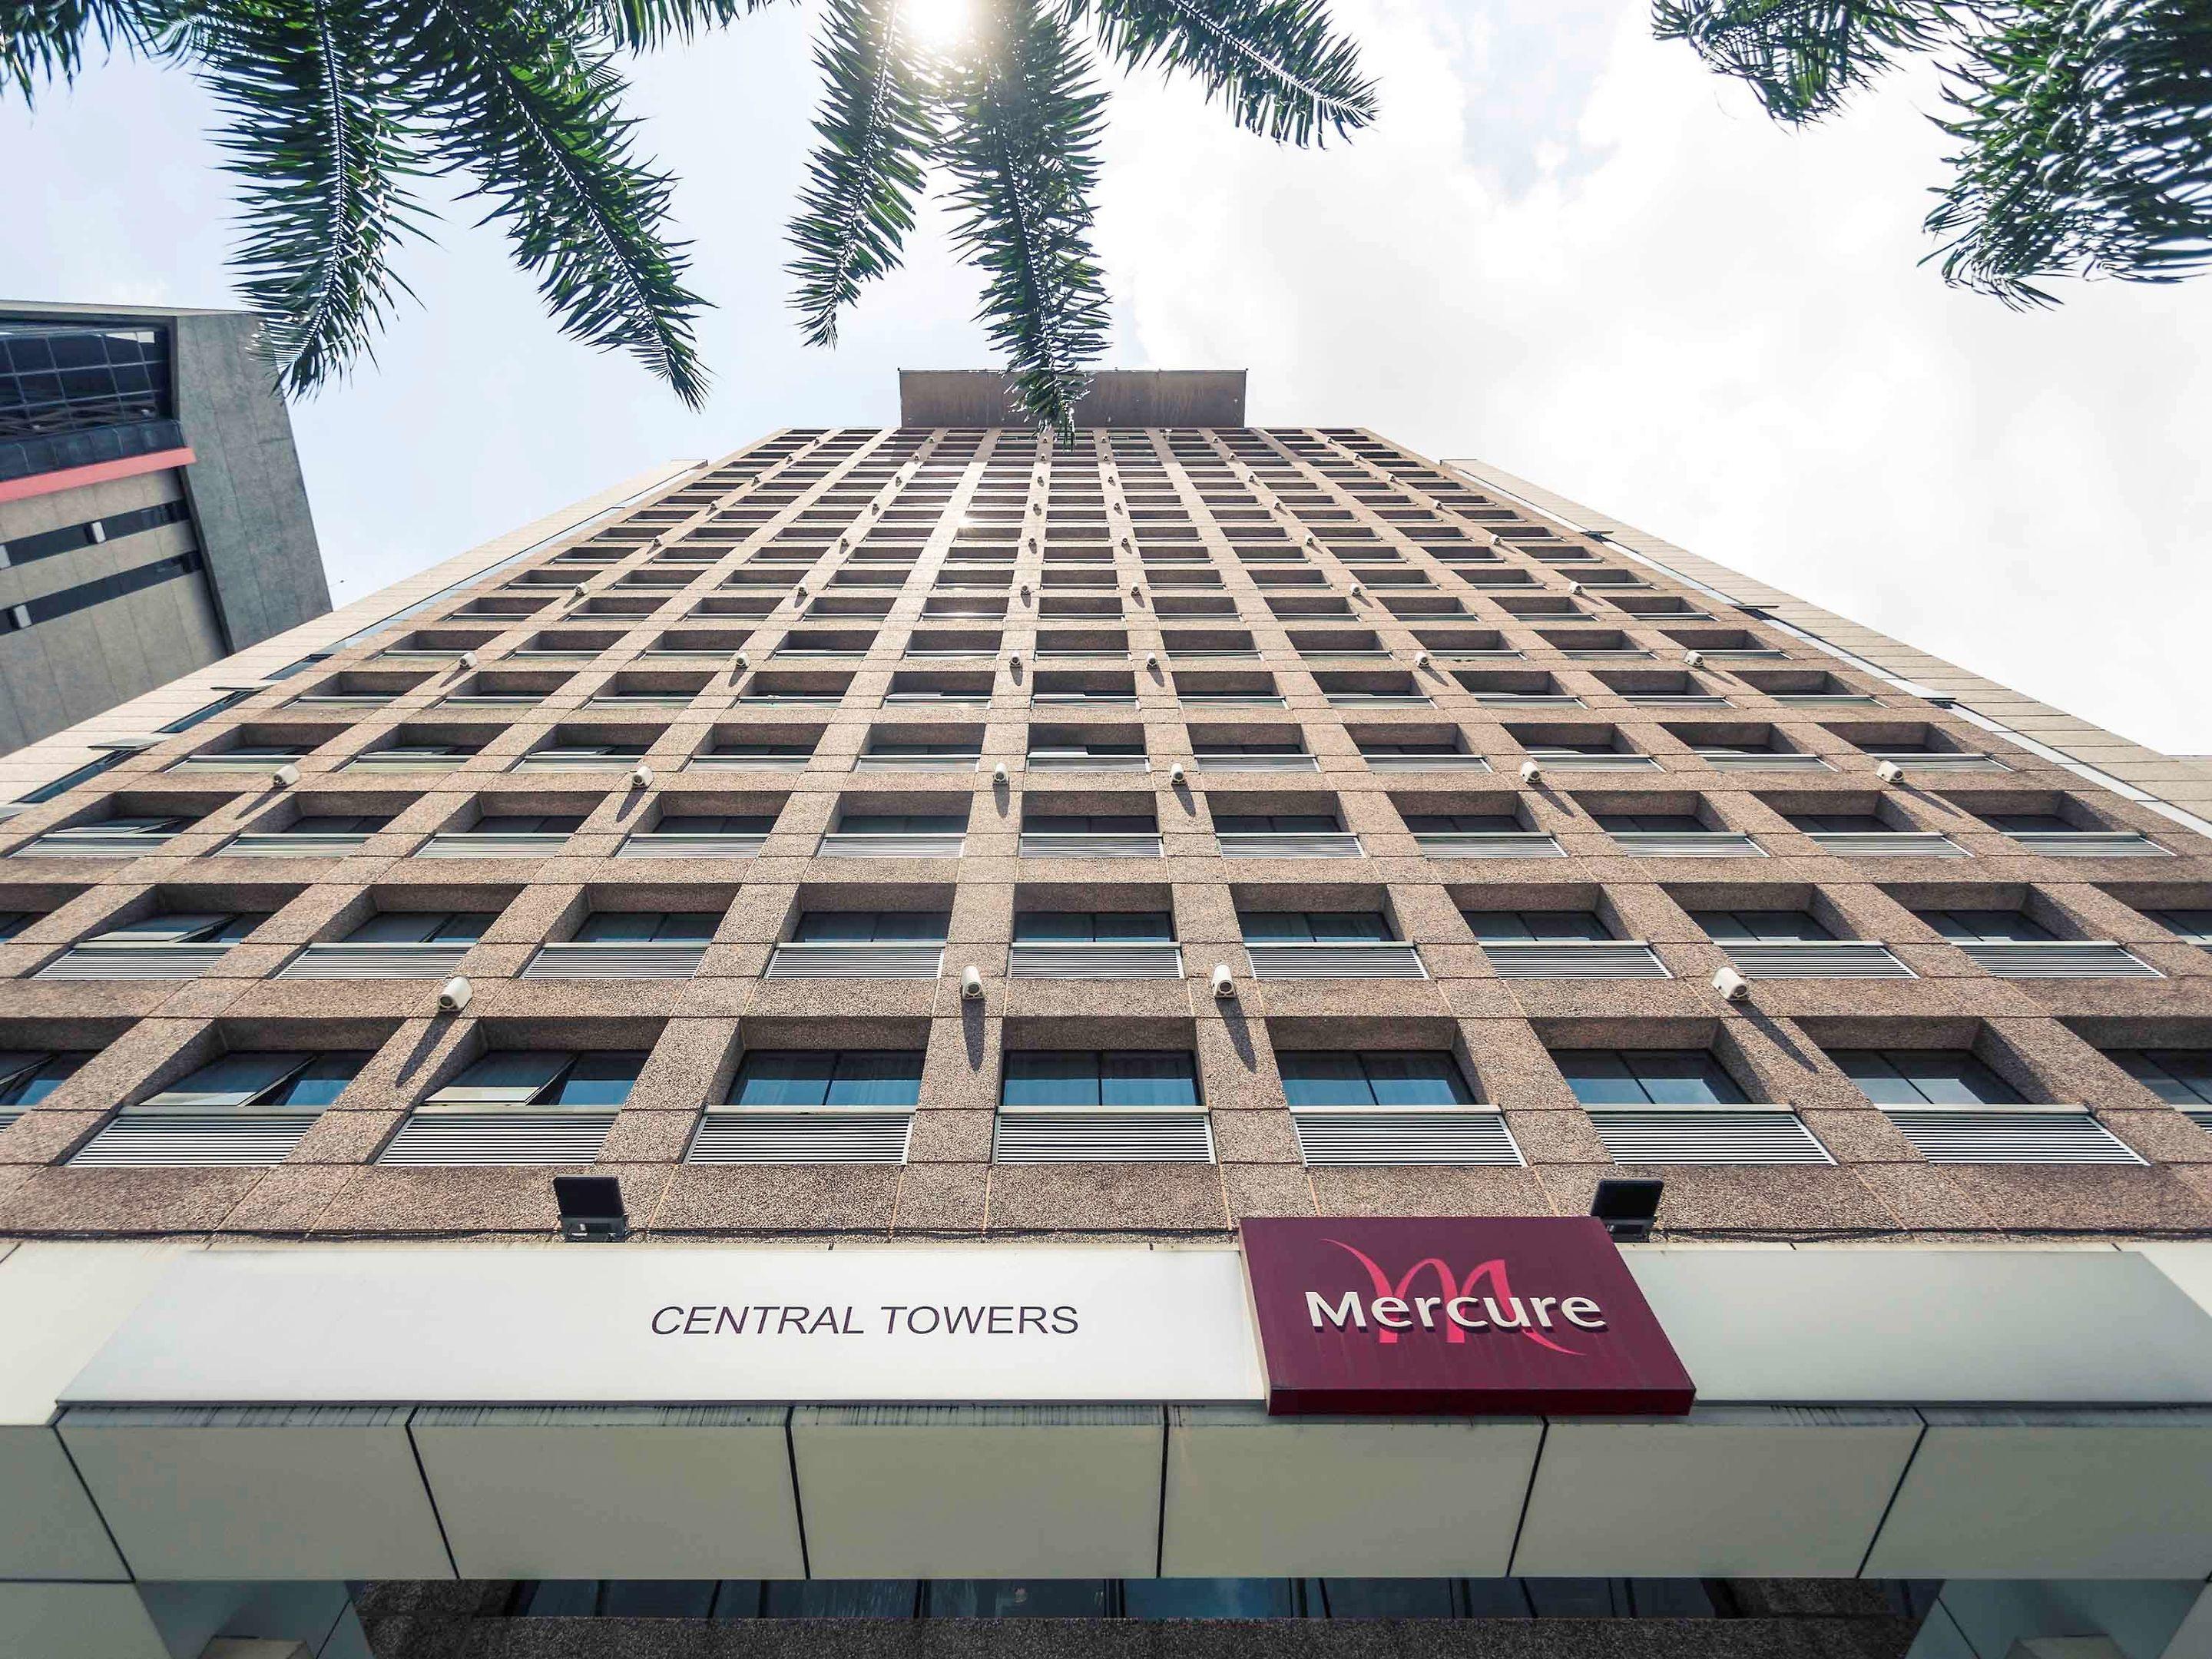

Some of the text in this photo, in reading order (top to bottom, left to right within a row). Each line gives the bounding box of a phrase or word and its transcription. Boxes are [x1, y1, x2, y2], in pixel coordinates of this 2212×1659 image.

[651, 1305, 1079, 1335] CENTRAL TOWERS
[1304, 1290, 1608, 1329] Mercure
